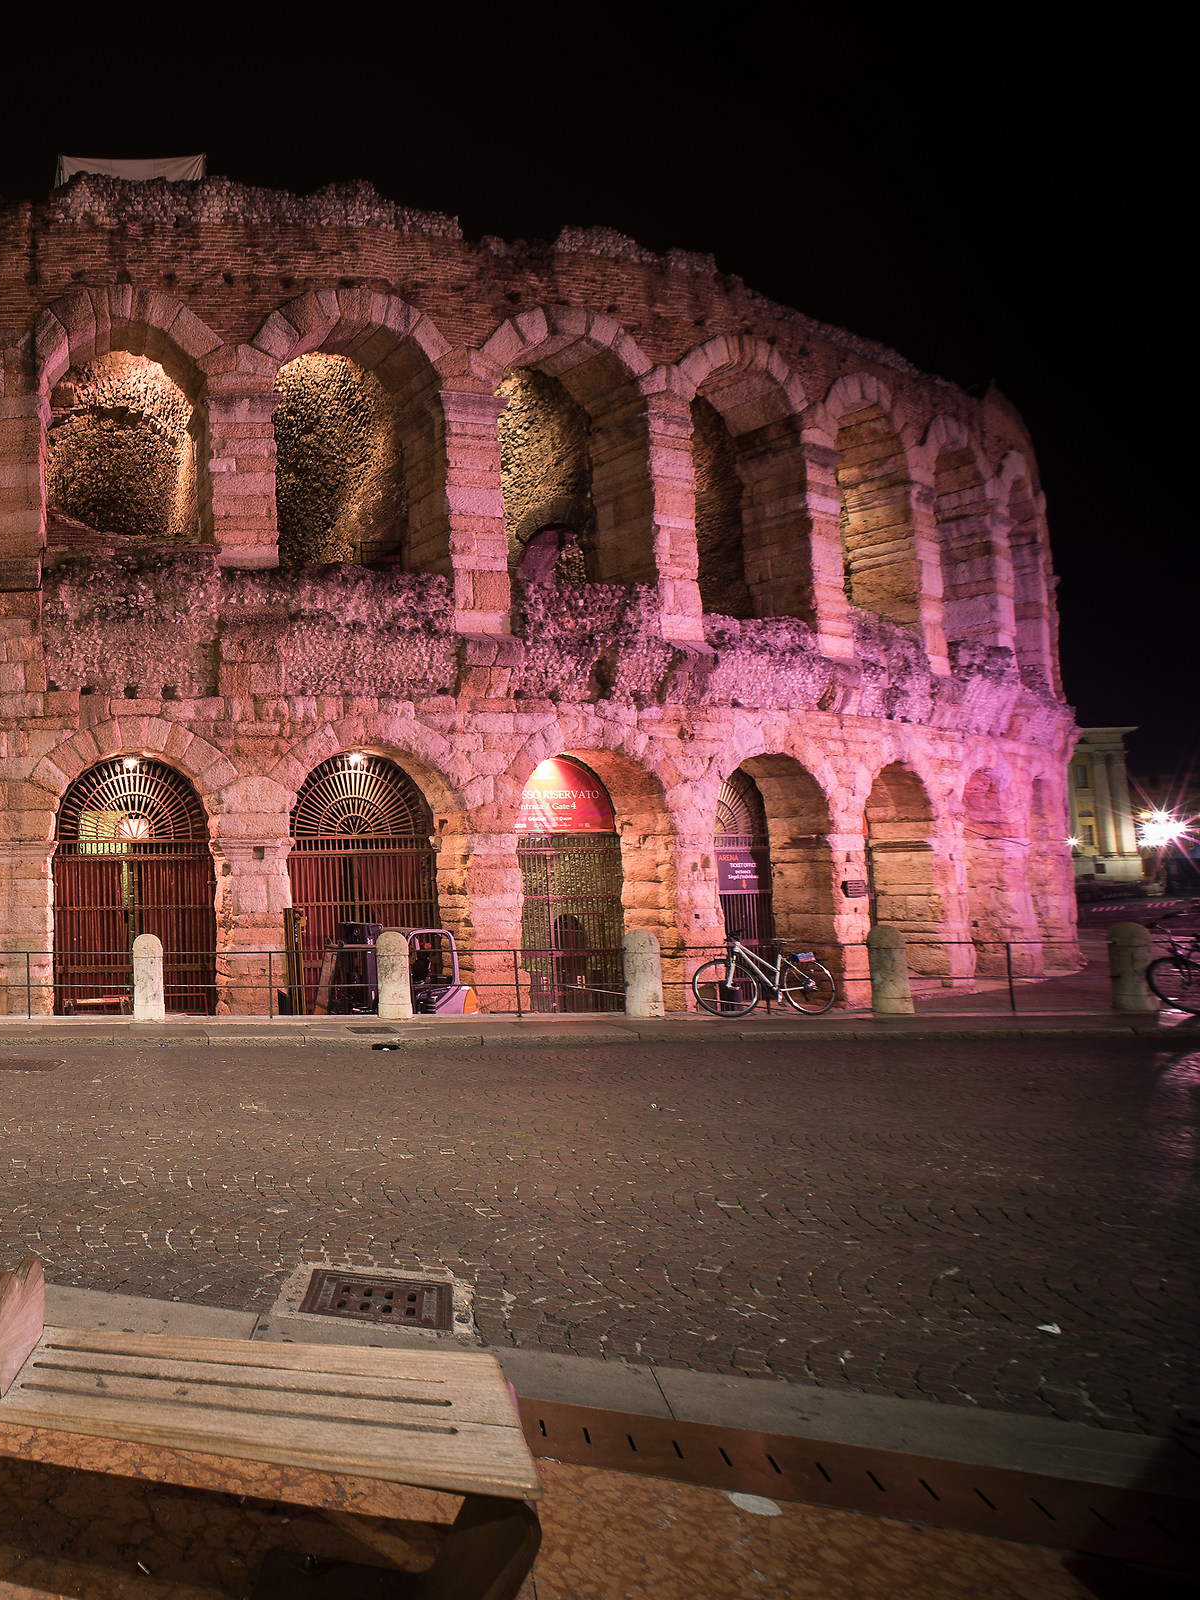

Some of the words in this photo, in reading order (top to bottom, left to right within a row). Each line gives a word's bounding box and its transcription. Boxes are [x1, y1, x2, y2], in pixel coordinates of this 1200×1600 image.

[521, 790, 542, 799] SSO
[543, 790, 599, 799] RISERVATO
[570, 802, 577, 810] 4
